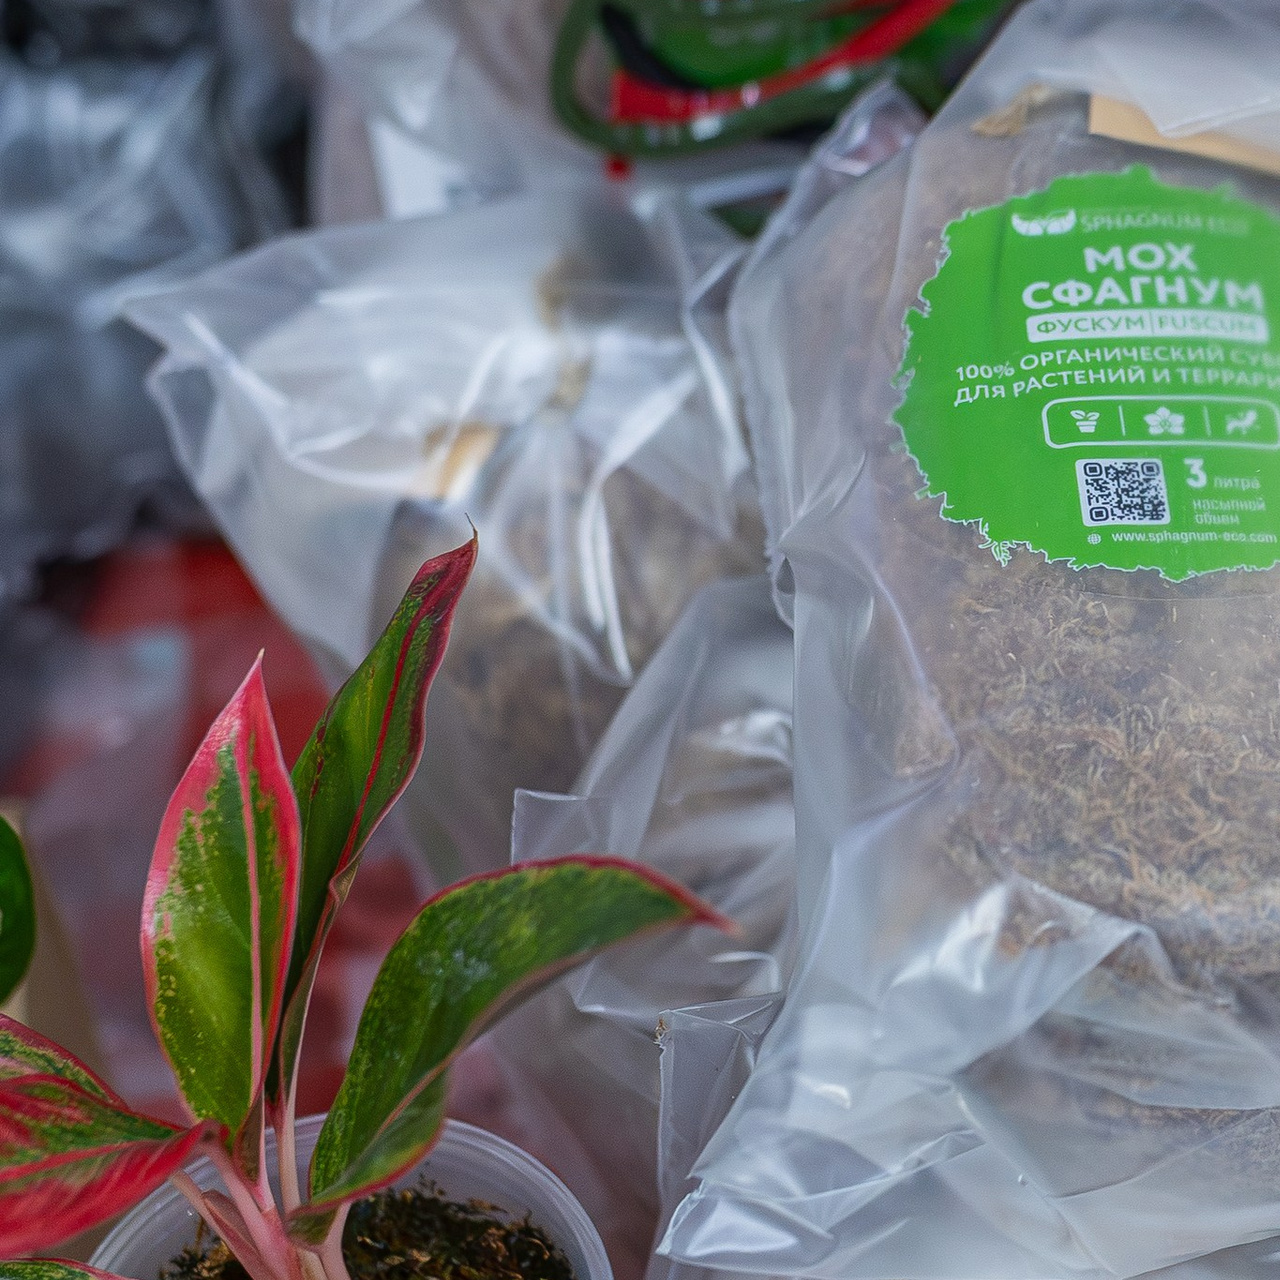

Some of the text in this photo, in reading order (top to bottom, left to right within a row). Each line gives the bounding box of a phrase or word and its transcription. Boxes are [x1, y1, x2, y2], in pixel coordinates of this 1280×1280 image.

[1083, 242, 1197, 273] МОХ
[1022, 276, 1266, 310] СФАГНУМ
[1036, 314, 1144, 334] ФУСКУМ
[956, 362, 1016, 383] 100%
[1019, 344, 1225, 370] ОРГАНИЧЕСКИЙ
[953, 384, 1006, 407] ДЛЯ
[1012, 365, 1146, 397] РАСТЕНИЙ
[1152, 368, 1170, 384] И
[1183, 458, 1208, 489] 3
